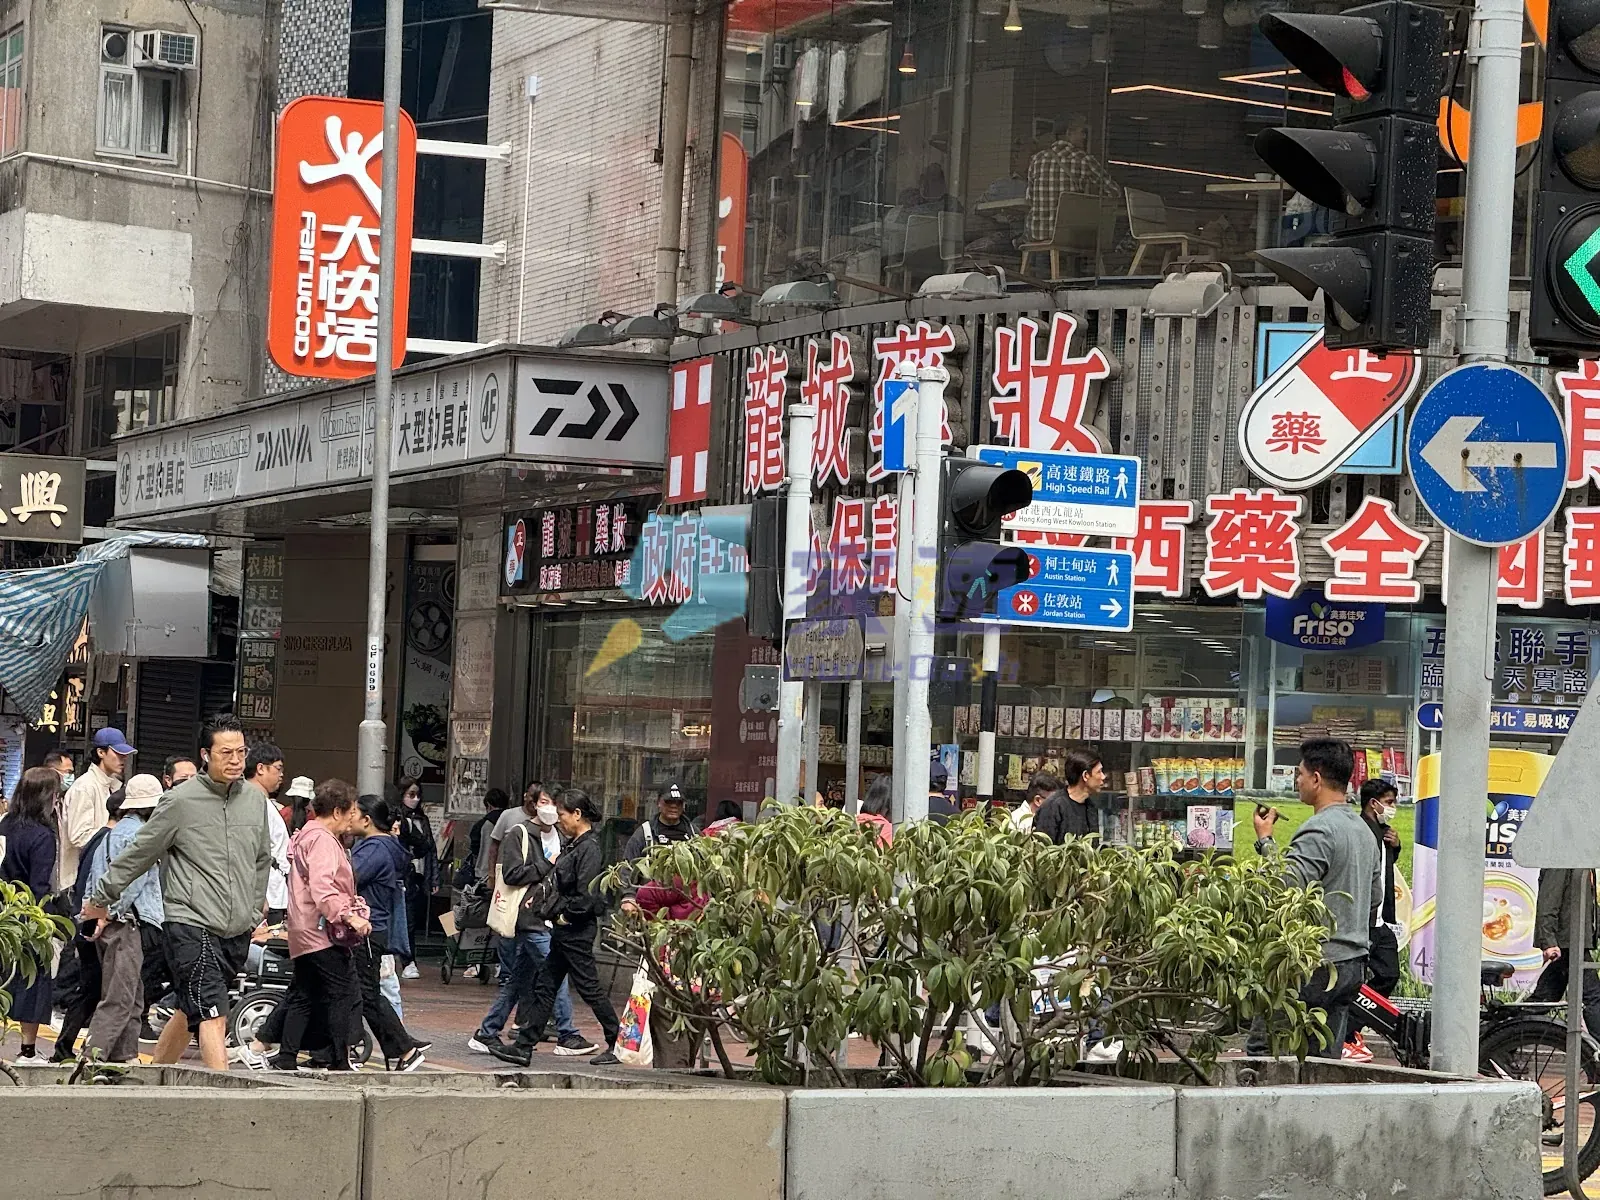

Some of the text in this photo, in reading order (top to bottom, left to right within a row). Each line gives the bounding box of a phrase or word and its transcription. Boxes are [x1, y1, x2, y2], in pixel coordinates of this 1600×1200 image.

[314, 215, 381, 363] 大快活
[481, 388, 497, 431] 4F
[398, 400, 469, 457] 大型釣具店
[1265, 411, 1328, 456] 藥
[135, 457, 185, 502] 大型釣具店
[1046, 462, 1111, 485] 高速鐵路
[1045, 482, 1110, 496] High Speed Rail
[1019, 503, 1084, 519] 香港西九龍站
[1018, 515, 1117, 529] Hong Kong West Kowloon Station
[1045, 555, 1097, 574] 柯士甸站
[1043, 572, 1086, 582] Austin Station
[1043, 591, 1083, 610] 佐敦站
[1043, 609, 1086, 619] Jordan Station
[1293, 614, 1355, 637] Friso
[1300, 635, 1331, 645] GOLD
[369, 644, 378, 692] CF 0699
[1421, 662, 1589, 695] 臨天實證
[1523, 712, 1572, 730] 易吸收
[1486, 844, 1508, 855] LD
[1414, 946, 1429, 977] 4
